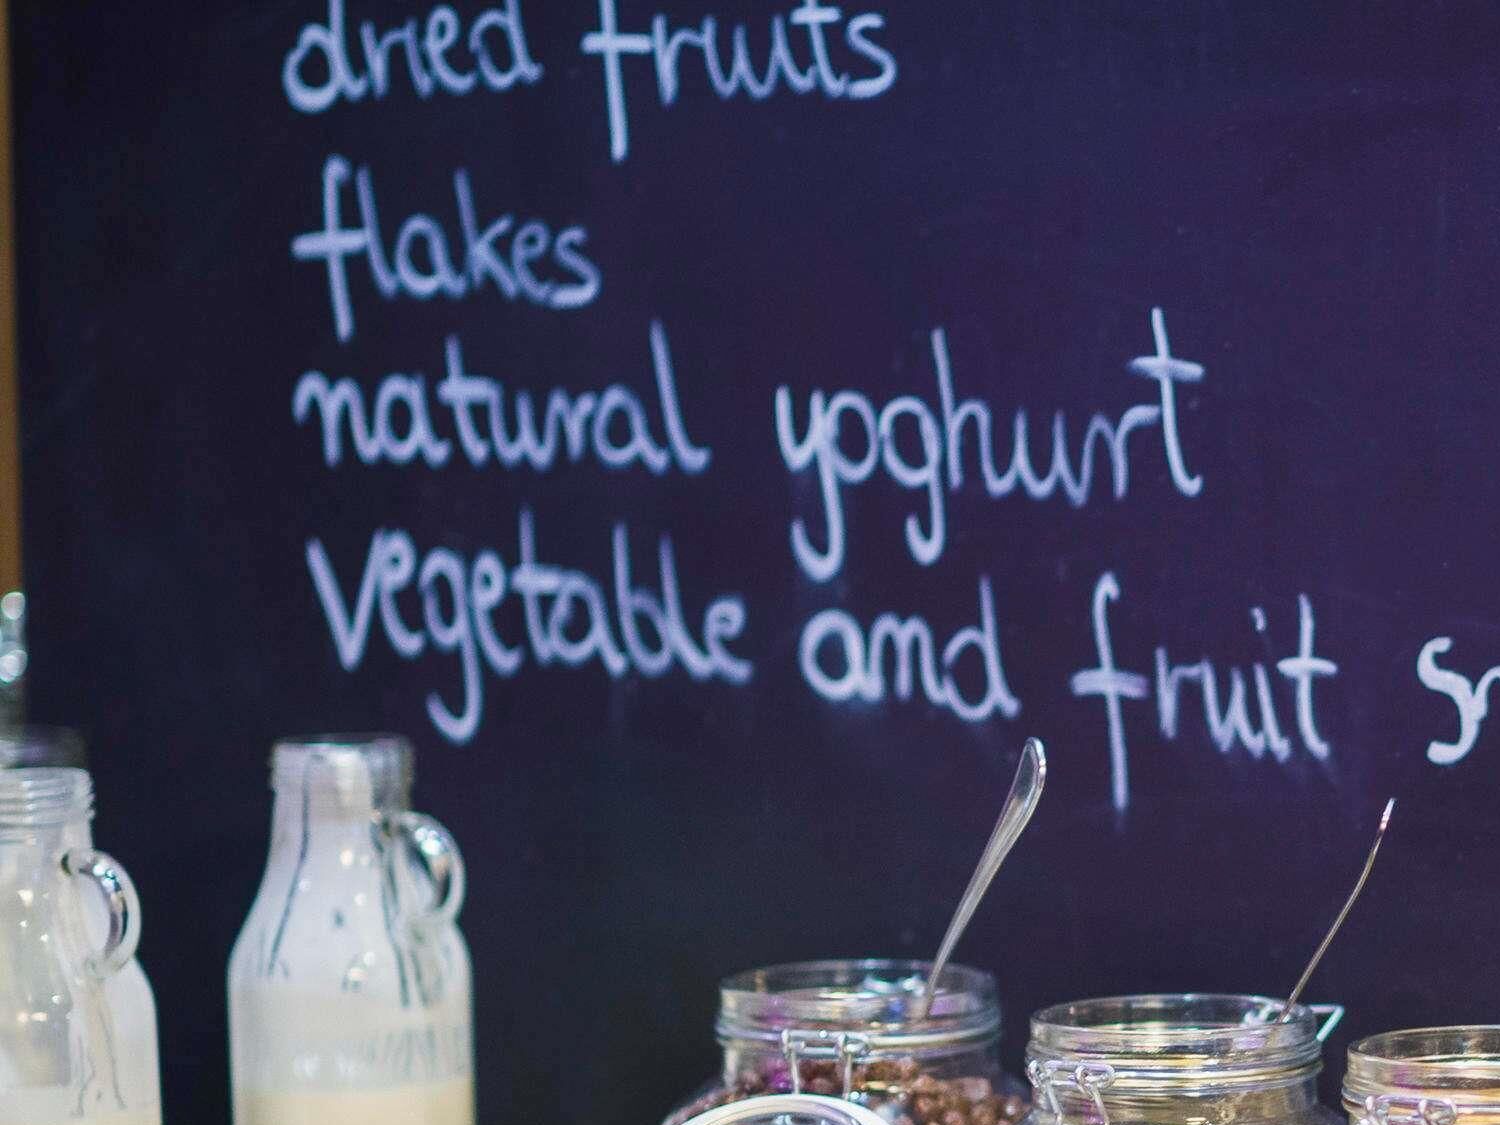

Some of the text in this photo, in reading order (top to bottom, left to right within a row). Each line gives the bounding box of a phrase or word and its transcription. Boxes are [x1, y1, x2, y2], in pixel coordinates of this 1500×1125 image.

[283, 0, 898, 162] dried fruits
[292, 156, 599, 343] flakes
[294, 307, 1205, 582] natural yoghurt
[305, 506, 752, 744] vegetable
[800, 575, 1020, 722] and
[1070, 570, 1338, 810] fruit
